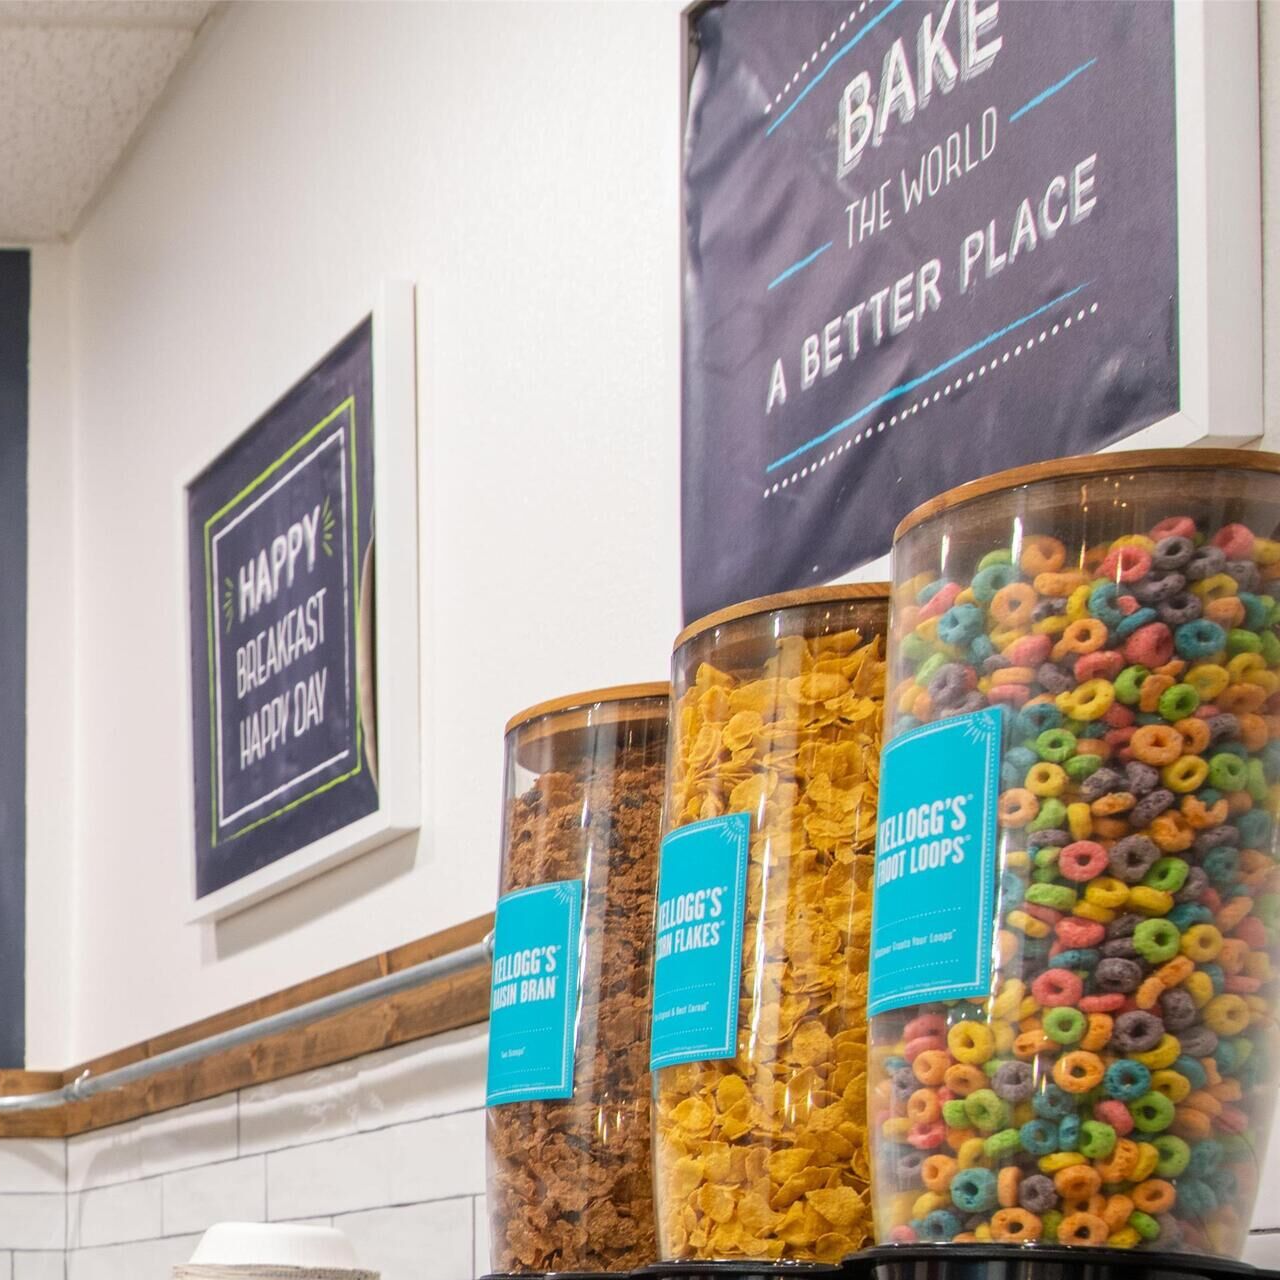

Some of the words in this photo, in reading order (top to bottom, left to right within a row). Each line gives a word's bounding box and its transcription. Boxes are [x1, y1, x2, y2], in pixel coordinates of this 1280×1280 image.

[838, 0, 1003, 181] BAKE
[845, 180, 892, 249] THE
[901, 105, 998, 214] WORLD
[766, 357, 787, 414] A
[800, 258, 942, 390] BETTER
[960, 153, 1097, 293] PLACE
[239, 505, 321, 623] HAPPY
[236, 588, 327, 700] BREAKFAST
[240, 691, 289, 770] HAPPY
[294, 667, 327, 738] DAY
[910, 836, 965, 874] LOOPS
[520, 975, 556, 1004] BRAN
[674, 921, 720, 954] FLAKES
